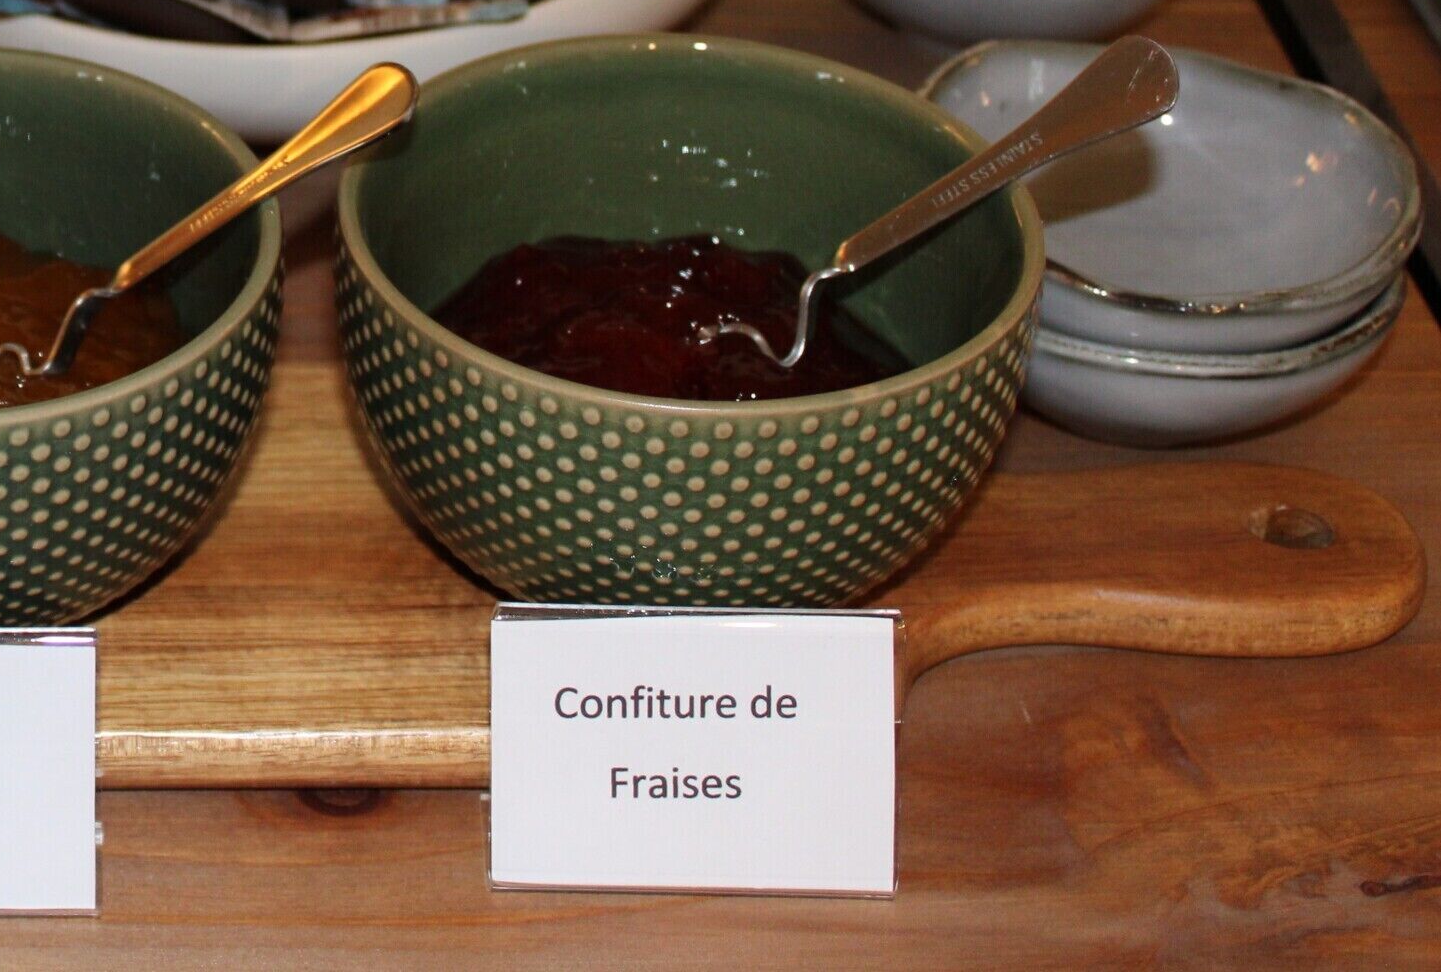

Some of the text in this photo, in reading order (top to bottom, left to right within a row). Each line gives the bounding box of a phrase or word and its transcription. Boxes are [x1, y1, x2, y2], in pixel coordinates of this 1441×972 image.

[969, 131, 1043, 186] STAINLESS
[554, 684, 798, 719] Confiture de
[610, 766, 742, 800] Fraises
